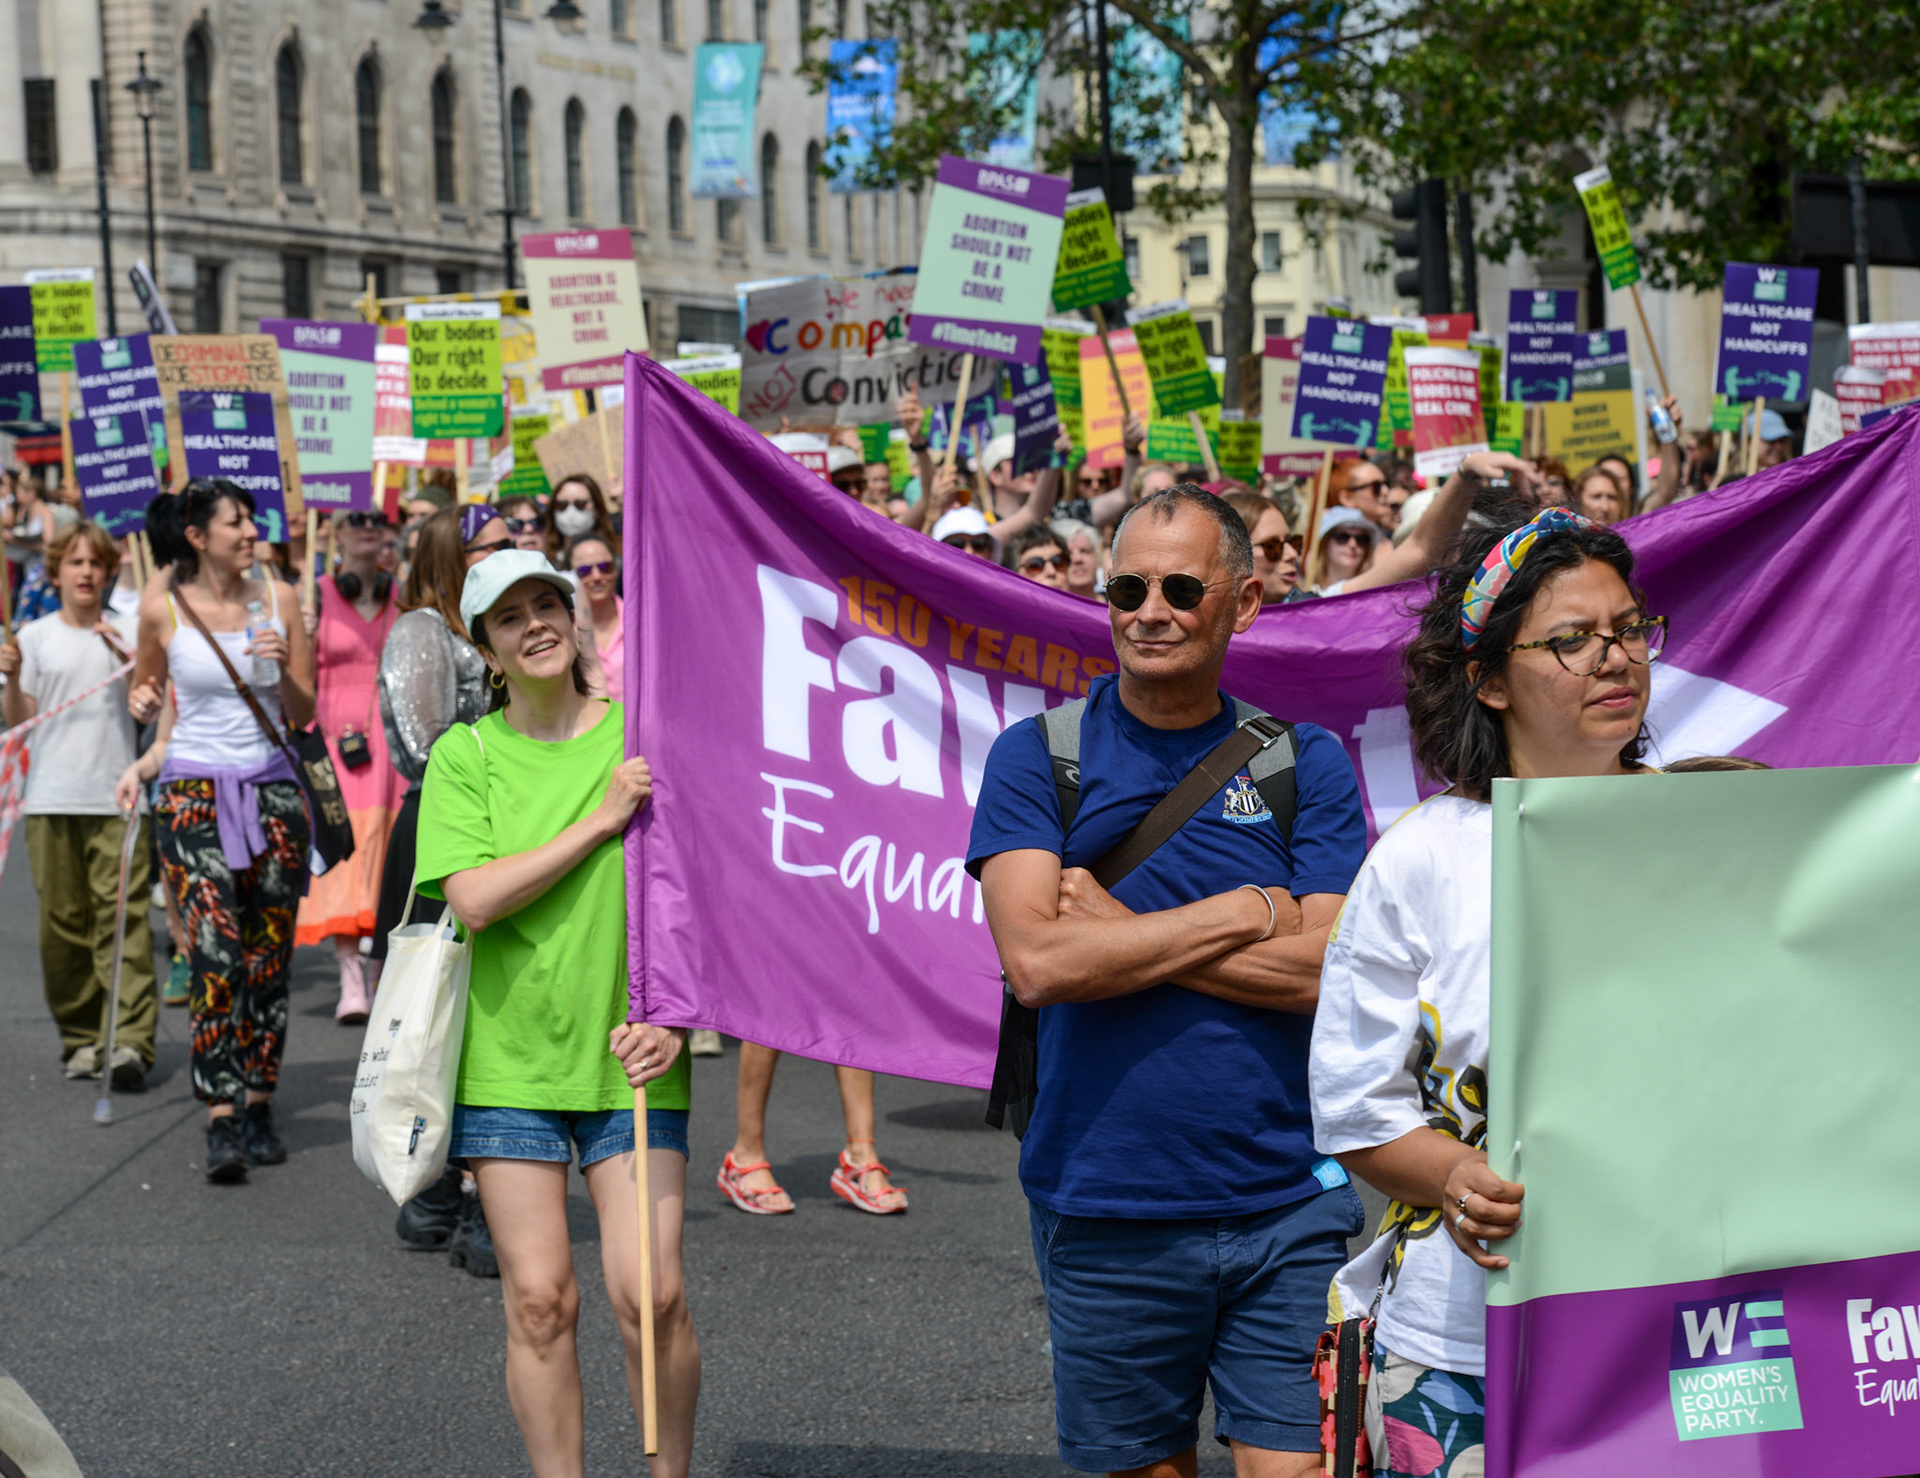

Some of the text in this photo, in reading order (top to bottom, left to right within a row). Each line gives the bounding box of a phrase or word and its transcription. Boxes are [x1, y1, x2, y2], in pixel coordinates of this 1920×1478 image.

[962, 212, 1029, 241] ABORTION
[951, 233, 1032, 264] SHOULD NOT
[971, 259, 1002, 280] BE A
[549, 270, 617, 290] ABORTION IS
[961, 280, 1004, 304] CRIME
[572, 308, 605, 326] NOT A
[1723, 302, 1814, 322] HEALTHCARE
[412, 322, 496, 341] Our bodies
[931, 321, 1018, 355] #TimeToAct
[1508, 321, 1576, 335] HEALTHCARE
[1750, 321, 1781, 336] NOT
[1529, 336, 1553, 350] NOT
[1724, 336, 1808, 356] HANDCUFFS
[413, 346, 485, 372] Our right
[1301, 351, 1387, 375] HEALTHCARE
[1510, 351, 1573, 366] HANDCUFFS
[78, 365, 158, 389] HEALTHCARE
[289, 371, 346, 390] ABORTION
[414, 371, 431, 390] to
[437, 371, 488, 390] decide
[1326, 370, 1357, 387] NOT
[106, 384, 135, 400] NOT
[1301, 384, 1381, 407] HANDCUFFS
[88, 396, 163, 419] HANDCUFFS
[289, 394, 351, 412] HOULD NOT
[302, 416, 328, 432] BE A
[183, 434, 278, 451] HEALTHCARE
[296, 438, 333, 455] CRIME
[74, 443, 150, 468] HEALTHCARE
[218, 454, 250, 470] NOT
[102, 463, 129, 479] NOT
[85, 475, 155, 499] HANDCUFFS
[838, 574, 1117, 697] 150 YEARS
[1678, 1365, 1783, 1393] WOMEN'S
[1680, 1385, 1790, 1413] EQUALITY
[1684, 1407, 1765, 1433] PARTY.
